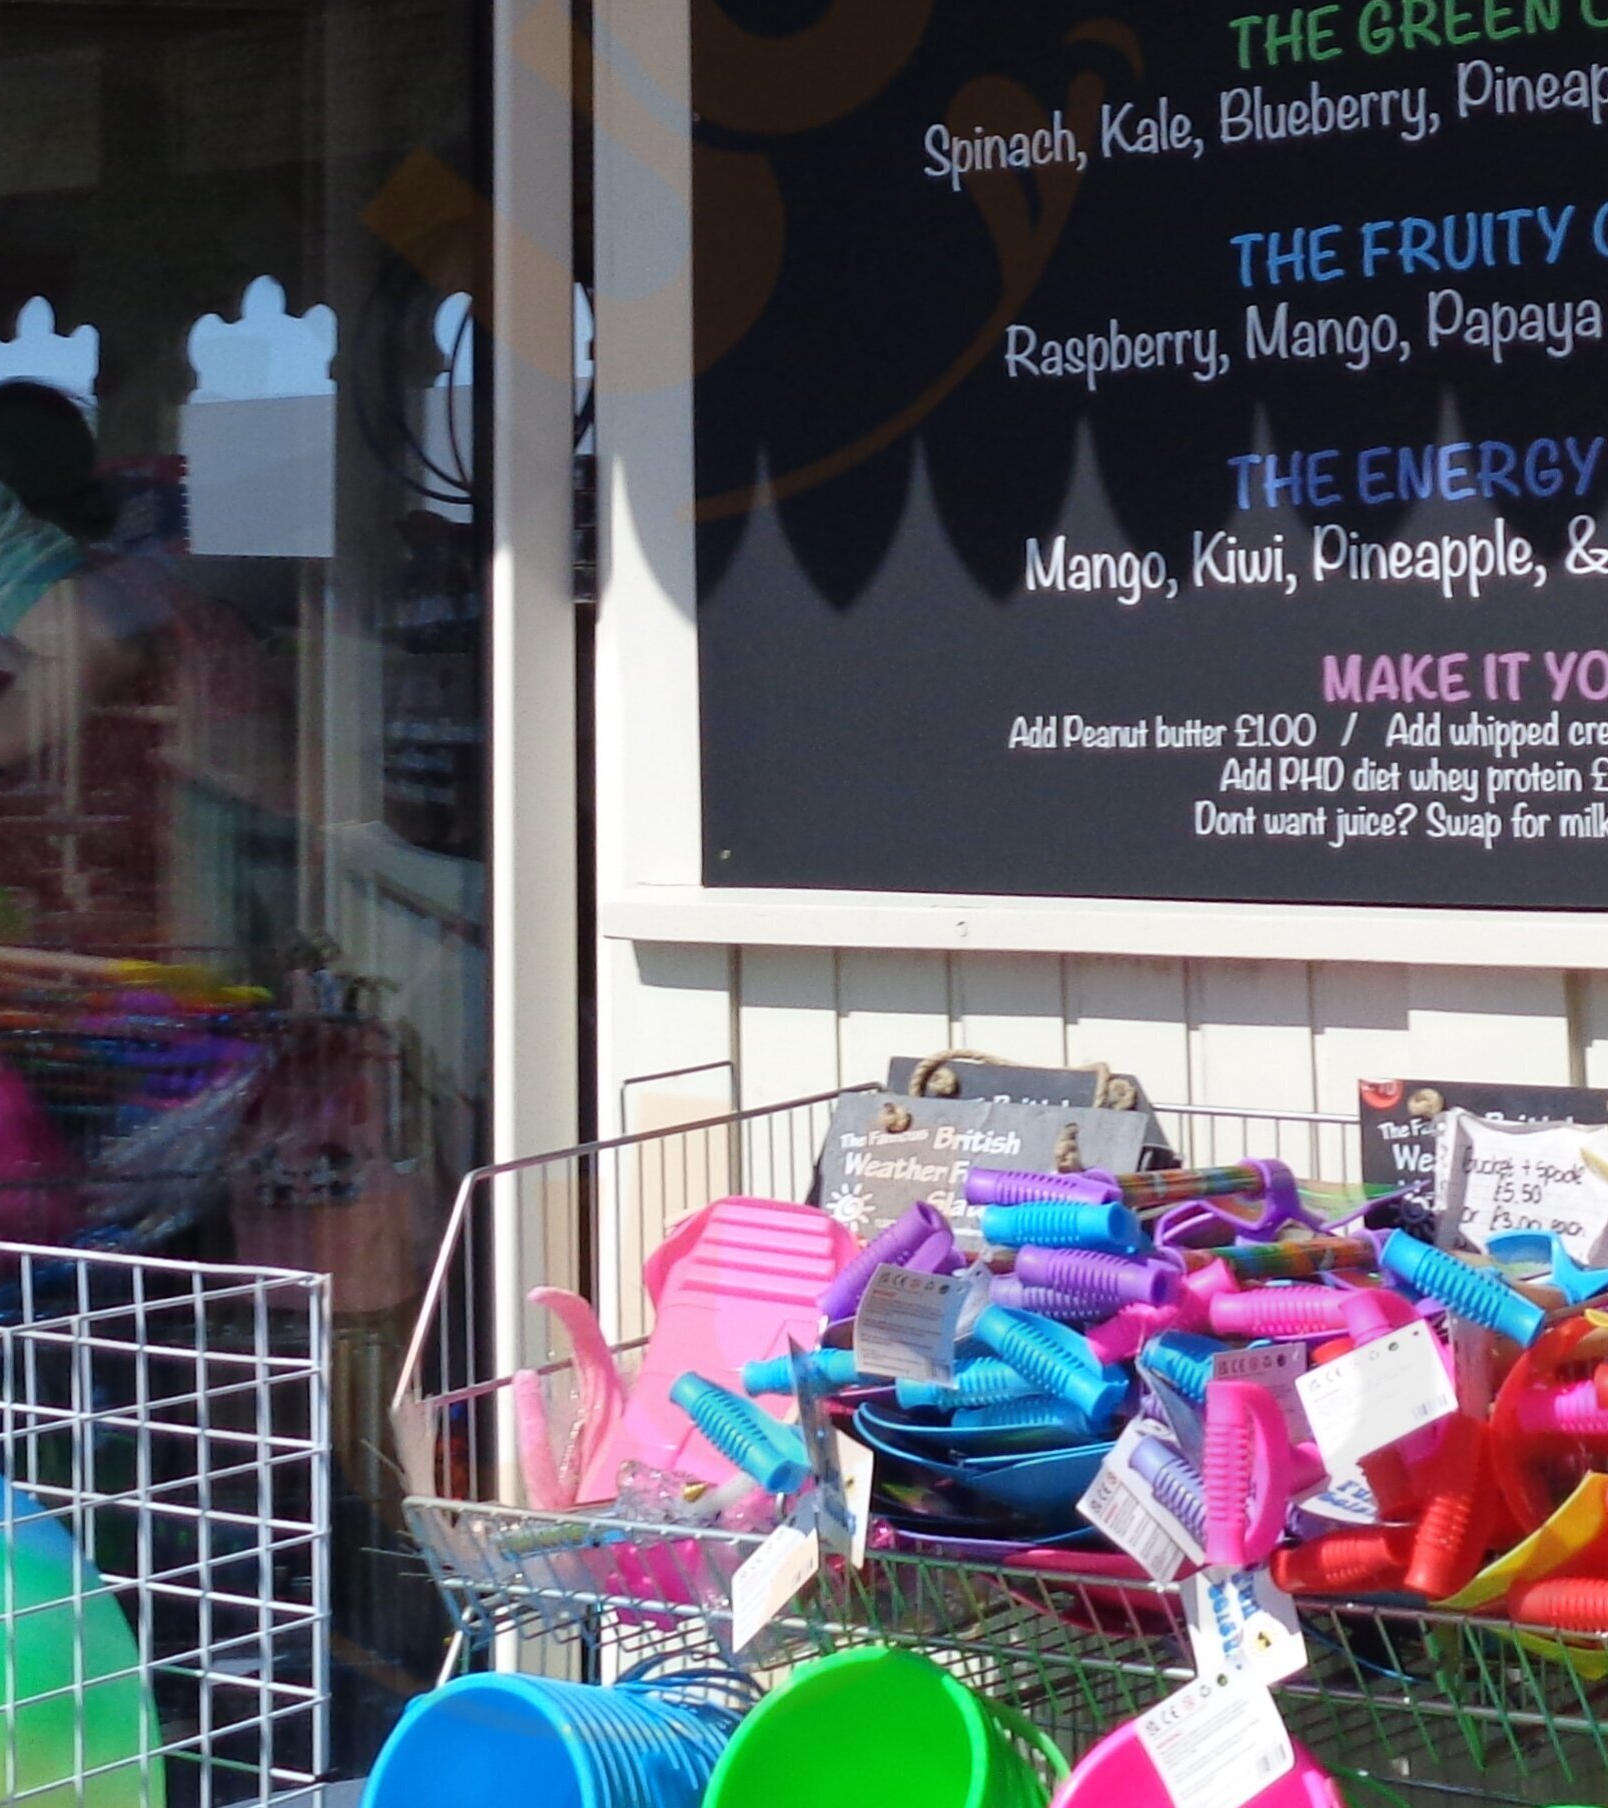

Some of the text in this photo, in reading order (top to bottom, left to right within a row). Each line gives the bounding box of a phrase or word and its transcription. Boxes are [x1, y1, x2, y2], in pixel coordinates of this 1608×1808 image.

[1228, 4, 1343, 70] THE
[923, 109, 1088, 193] Spinach,
[1101, 96, 1204, 159] Kale,
[1219, 80, 1441, 145] Blueberry,
[1229, 223, 1345, 288] THE
[1360, 204, 1576, 278] FRUITY
[1004, 318, 1230, 392] Raspberry,
[1245, 301, 1411, 371] Mango,
[1427, 288, 1603, 364] Papaya
[1227, 449, 1342, 513] THE
[1357, 434, 1605, 505] ENERGY
[1025, 534, 1178, 606] Mango,
[1192, 530, 1298, 595] Kiwi,
[1312, 516, 1548, 599] Pineapple,
[1323, 652, 1472, 704] MAKE
[1483, 651, 1531, 702] IT
[1008, 715, 1058, 749] Add
[1062, 714, 1150, 749] Peanut
[1154, 714, 1228, 749] butter
[1233, 712, 1317, 748] £1.00
[1339, 711, 1359, 747] /
[1384, 711, 1442, 748] Add
[1448, 709, 1560, 759] whipped
[1219, 756, 1272, 793] Add
[1278, 755, 1345, 793] PHD
[1351, 756, 1402, 792] diet
[1408, 756, 1479, 804] whey
[1486, 760, 1583, 805] protein
[1194, 799, 1258, 836] Dont
[1263, 806, 1328, 837] want
[1328, 802, 1419, 849] juice?
[1425, 801, 1503, 850] Swap
[1509, 801, 1552, 840] for
[844, 1152, 948, 1183] Weather
[933, 1126, 1021, 1155] British
